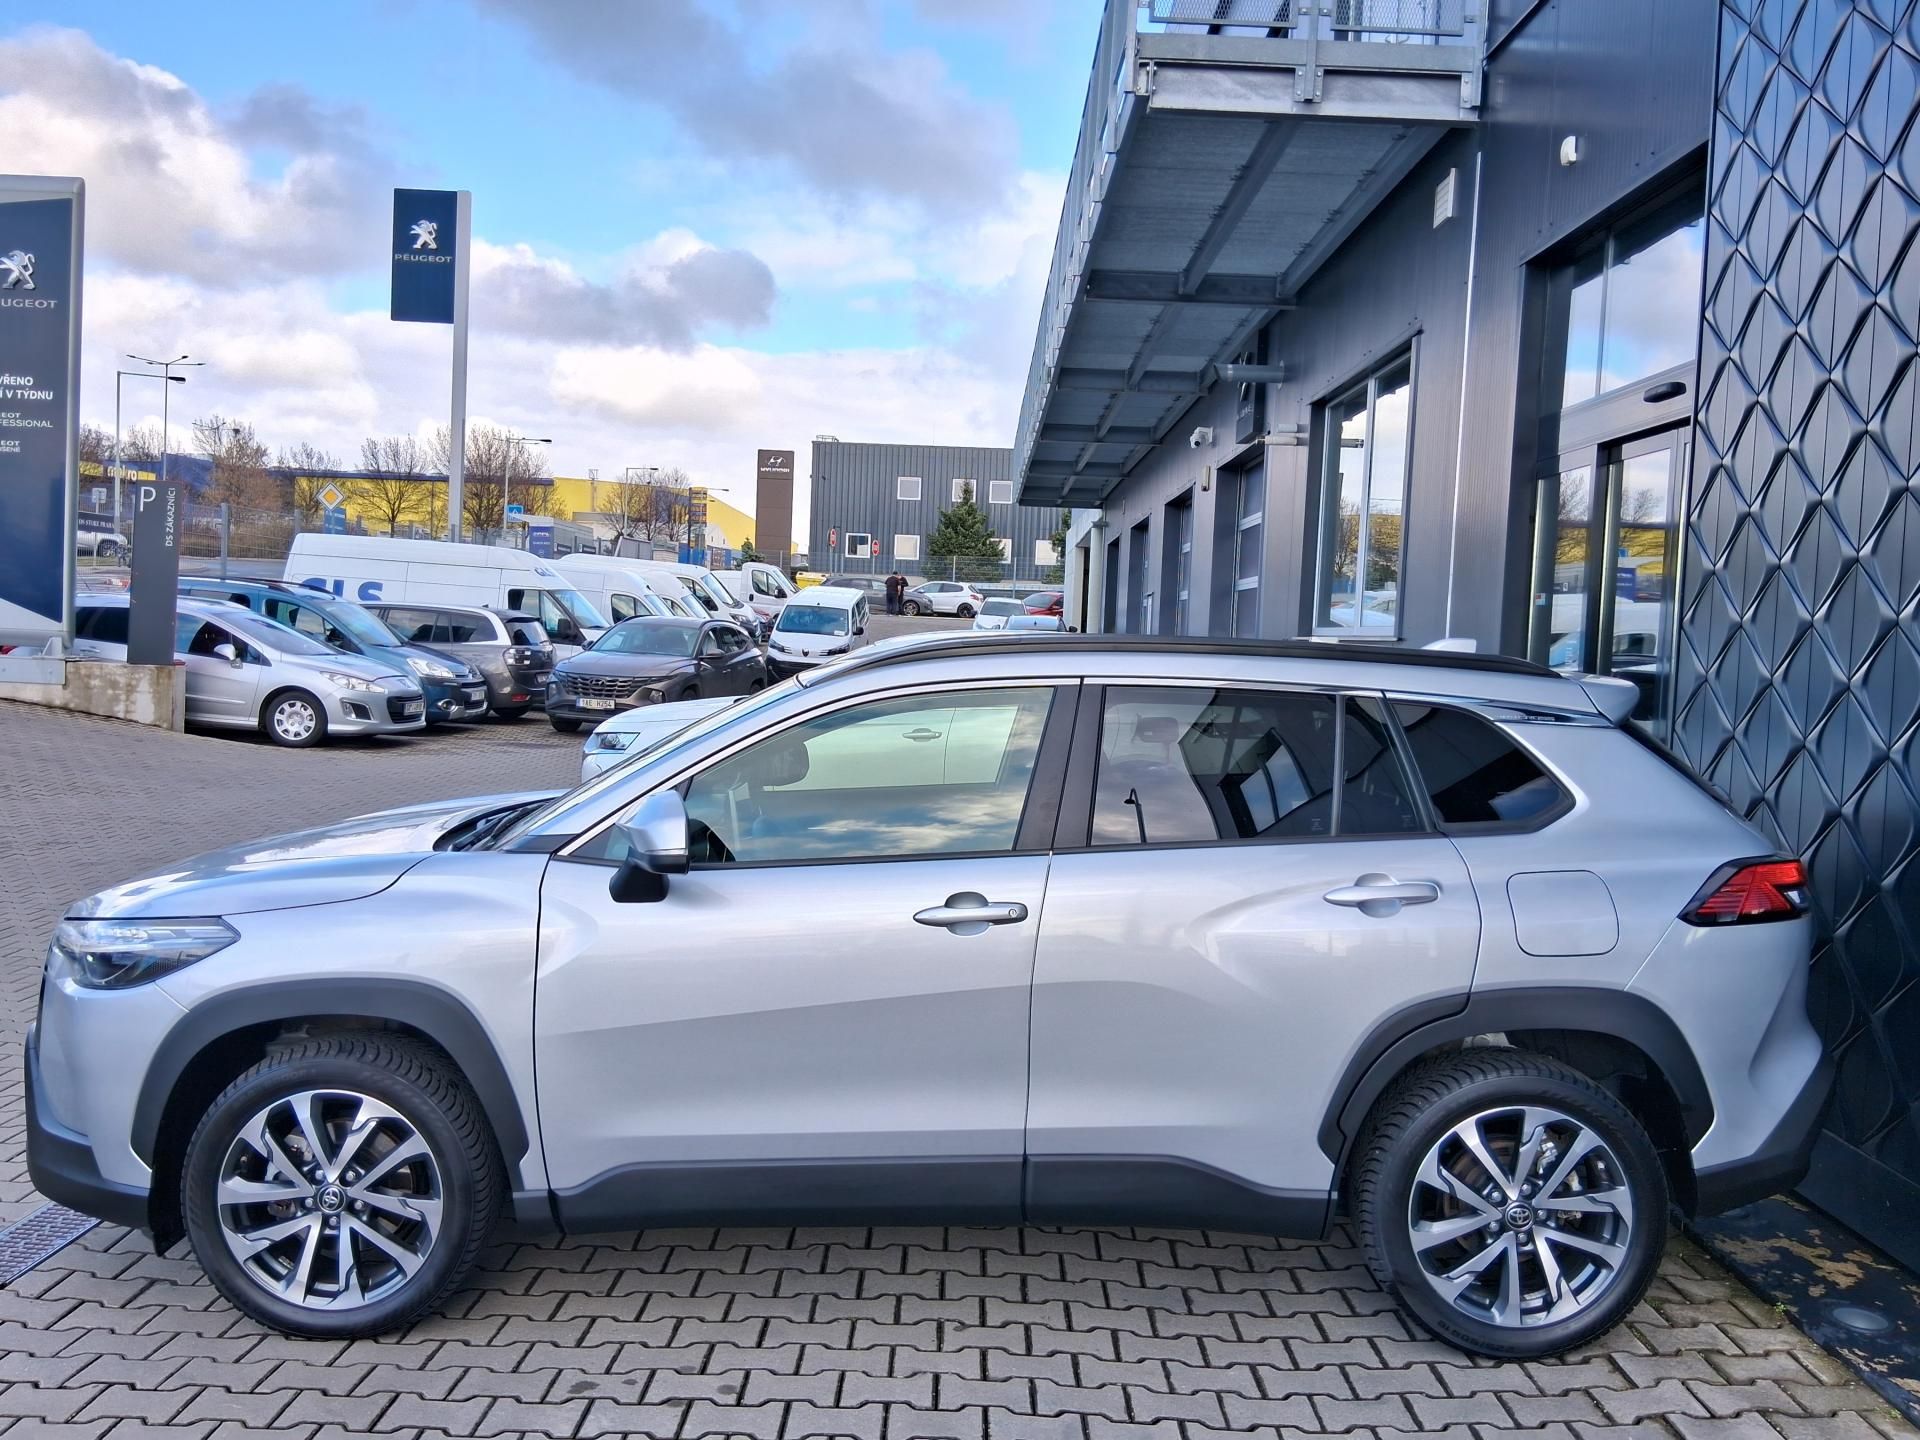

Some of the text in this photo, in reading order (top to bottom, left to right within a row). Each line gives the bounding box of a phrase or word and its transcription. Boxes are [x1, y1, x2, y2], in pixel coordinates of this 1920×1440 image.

[394, 253, 453, 263] PEUGEOT
[5, 389, 14, 399] V
[16, 388, 54, 400] TÝDNU
[140, 486, 157, 512] P
[165, 535, 174, 547] DS
